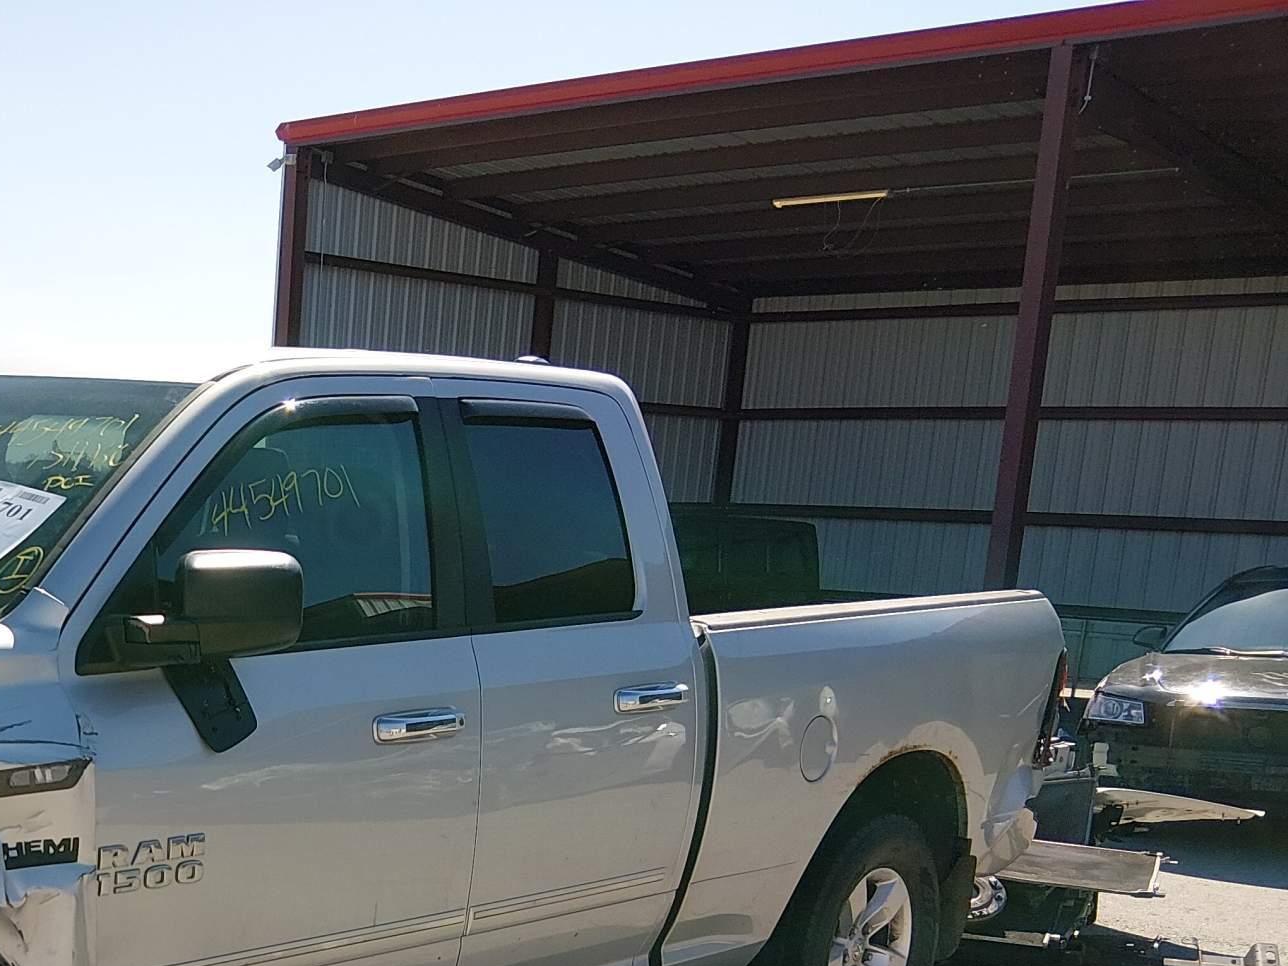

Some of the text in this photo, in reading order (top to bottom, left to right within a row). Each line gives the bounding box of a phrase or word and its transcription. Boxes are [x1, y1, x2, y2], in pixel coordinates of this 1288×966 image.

[211, 464, 361, 537] 44549701
[2, 837, 79, 861] HEMI
[97, 832, 206, 871] RAM
[97, 859, 205, 897] 1500
